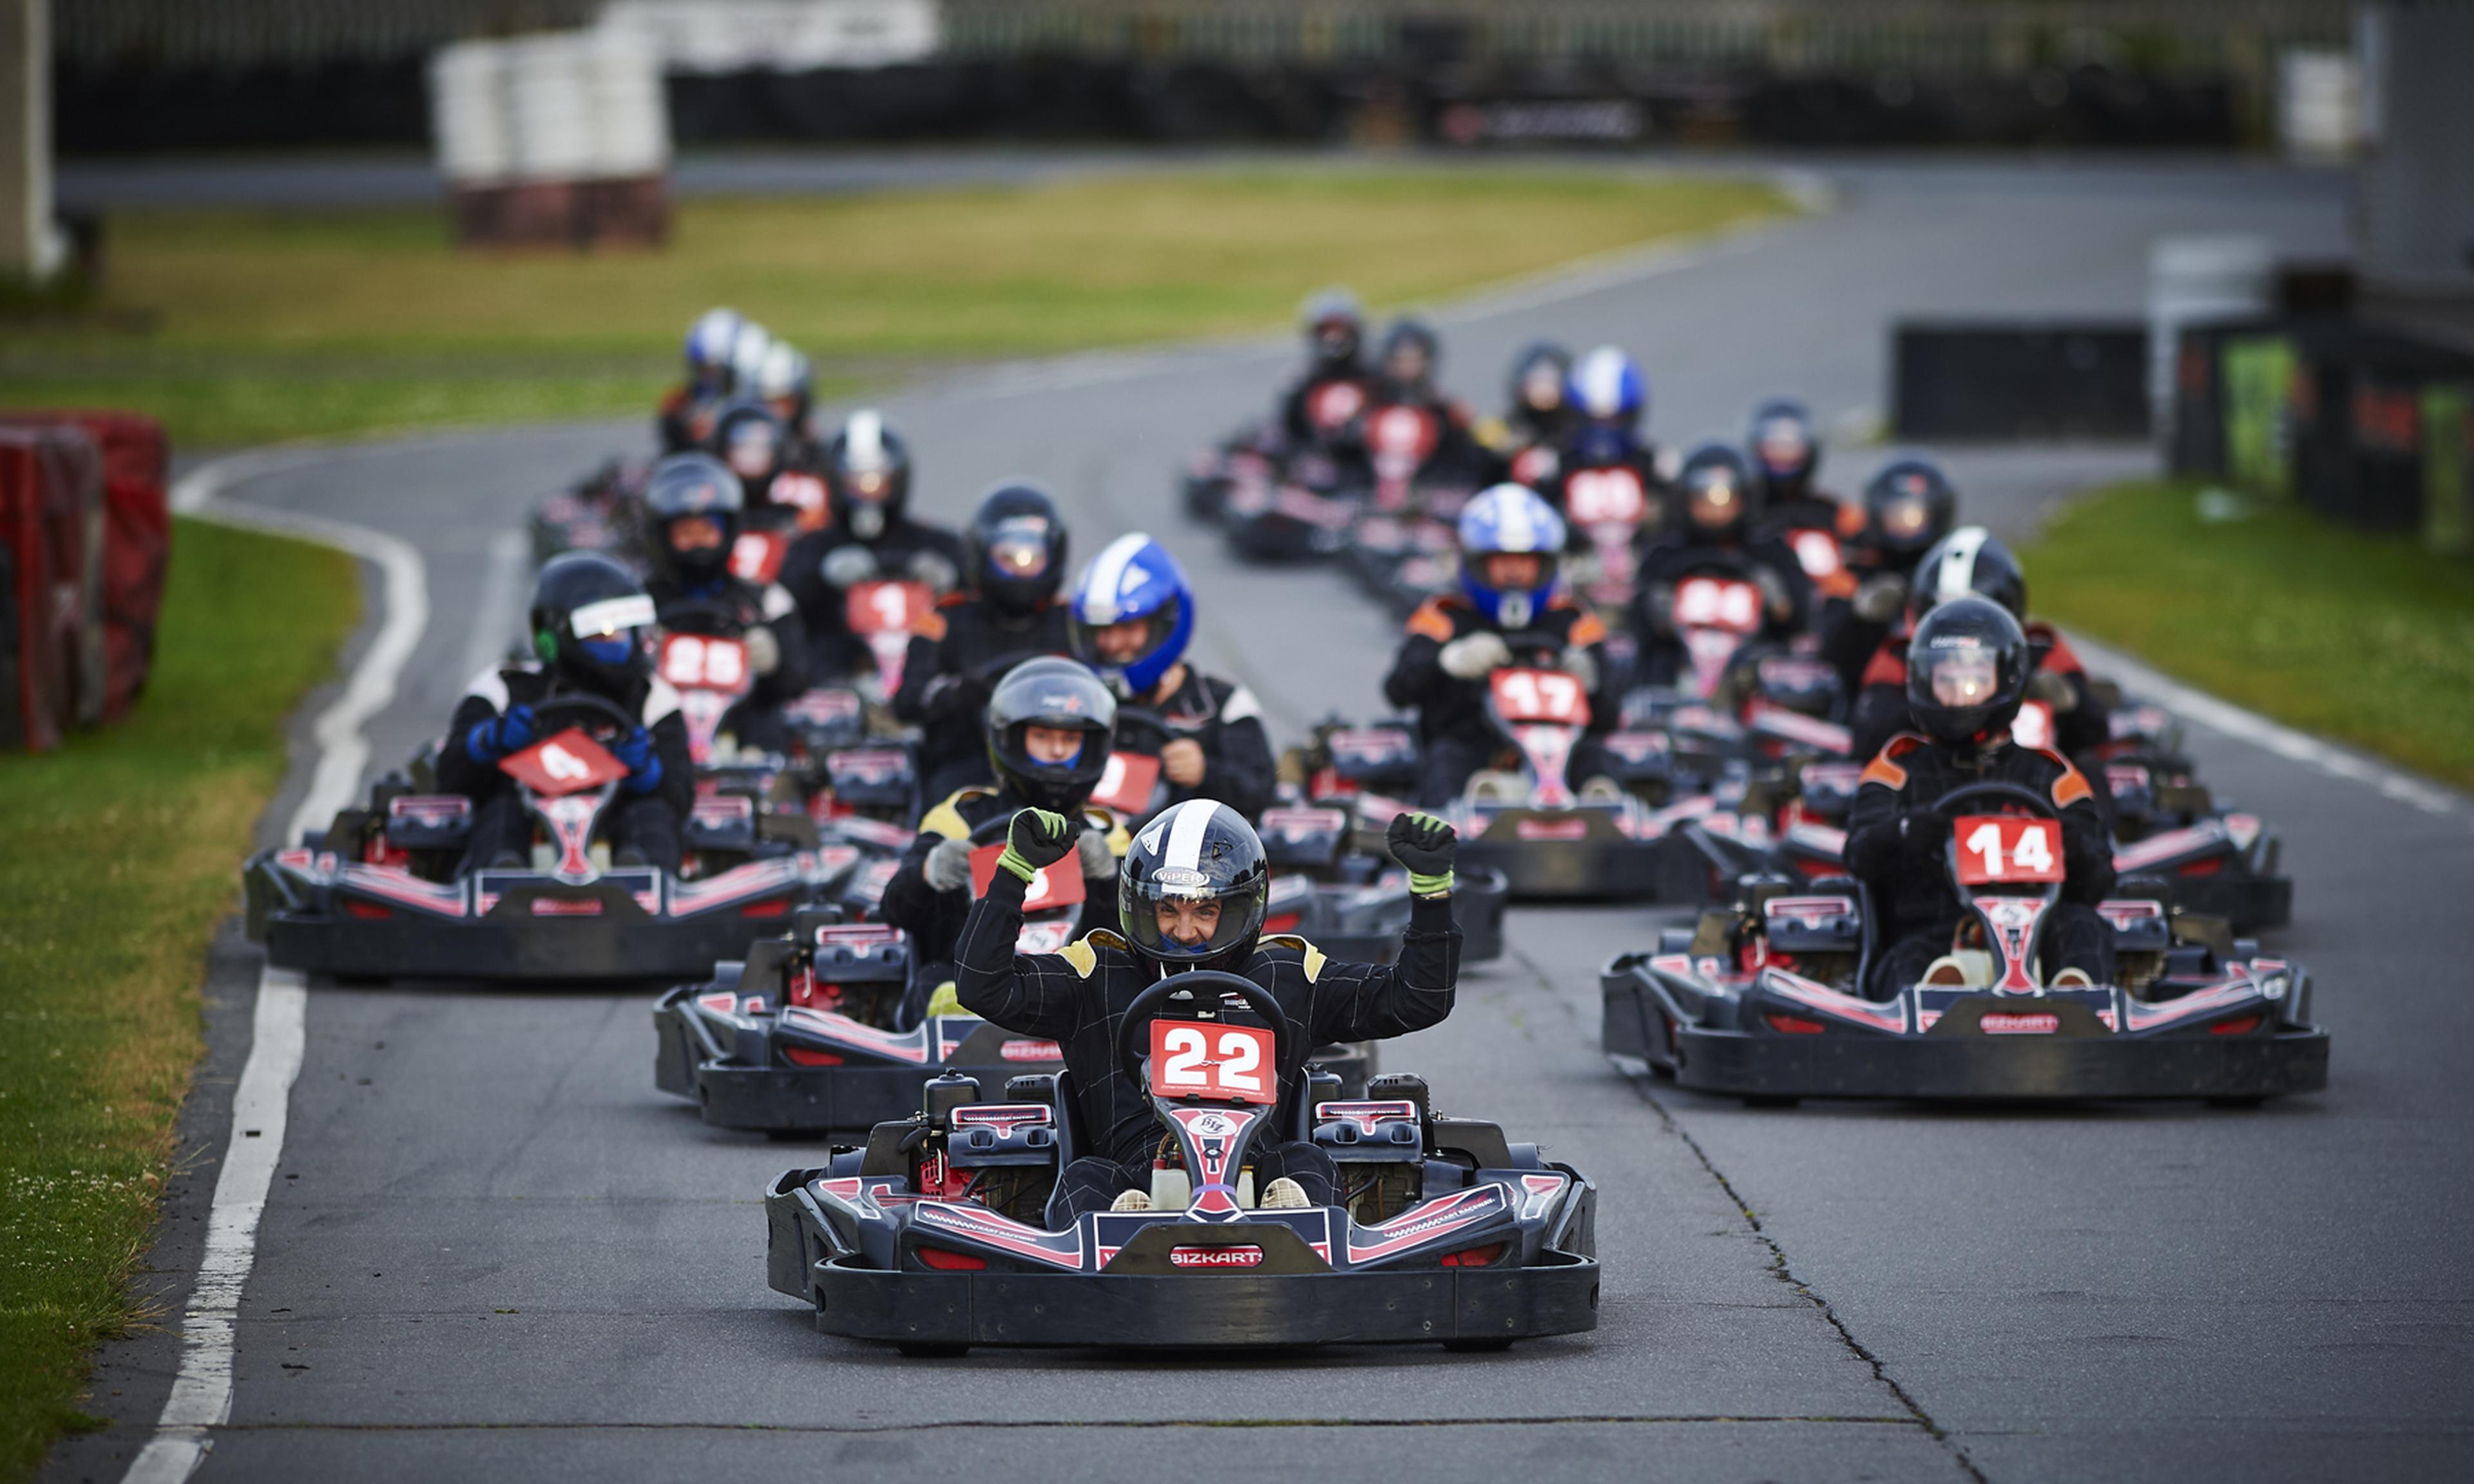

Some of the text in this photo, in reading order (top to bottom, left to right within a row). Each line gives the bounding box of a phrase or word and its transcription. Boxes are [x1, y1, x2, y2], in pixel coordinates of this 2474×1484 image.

[1500, 671, 1578, 718] 17
[1966, 823, 2055, 877] 14
[1164, 1027, 1261, 1092] 22
